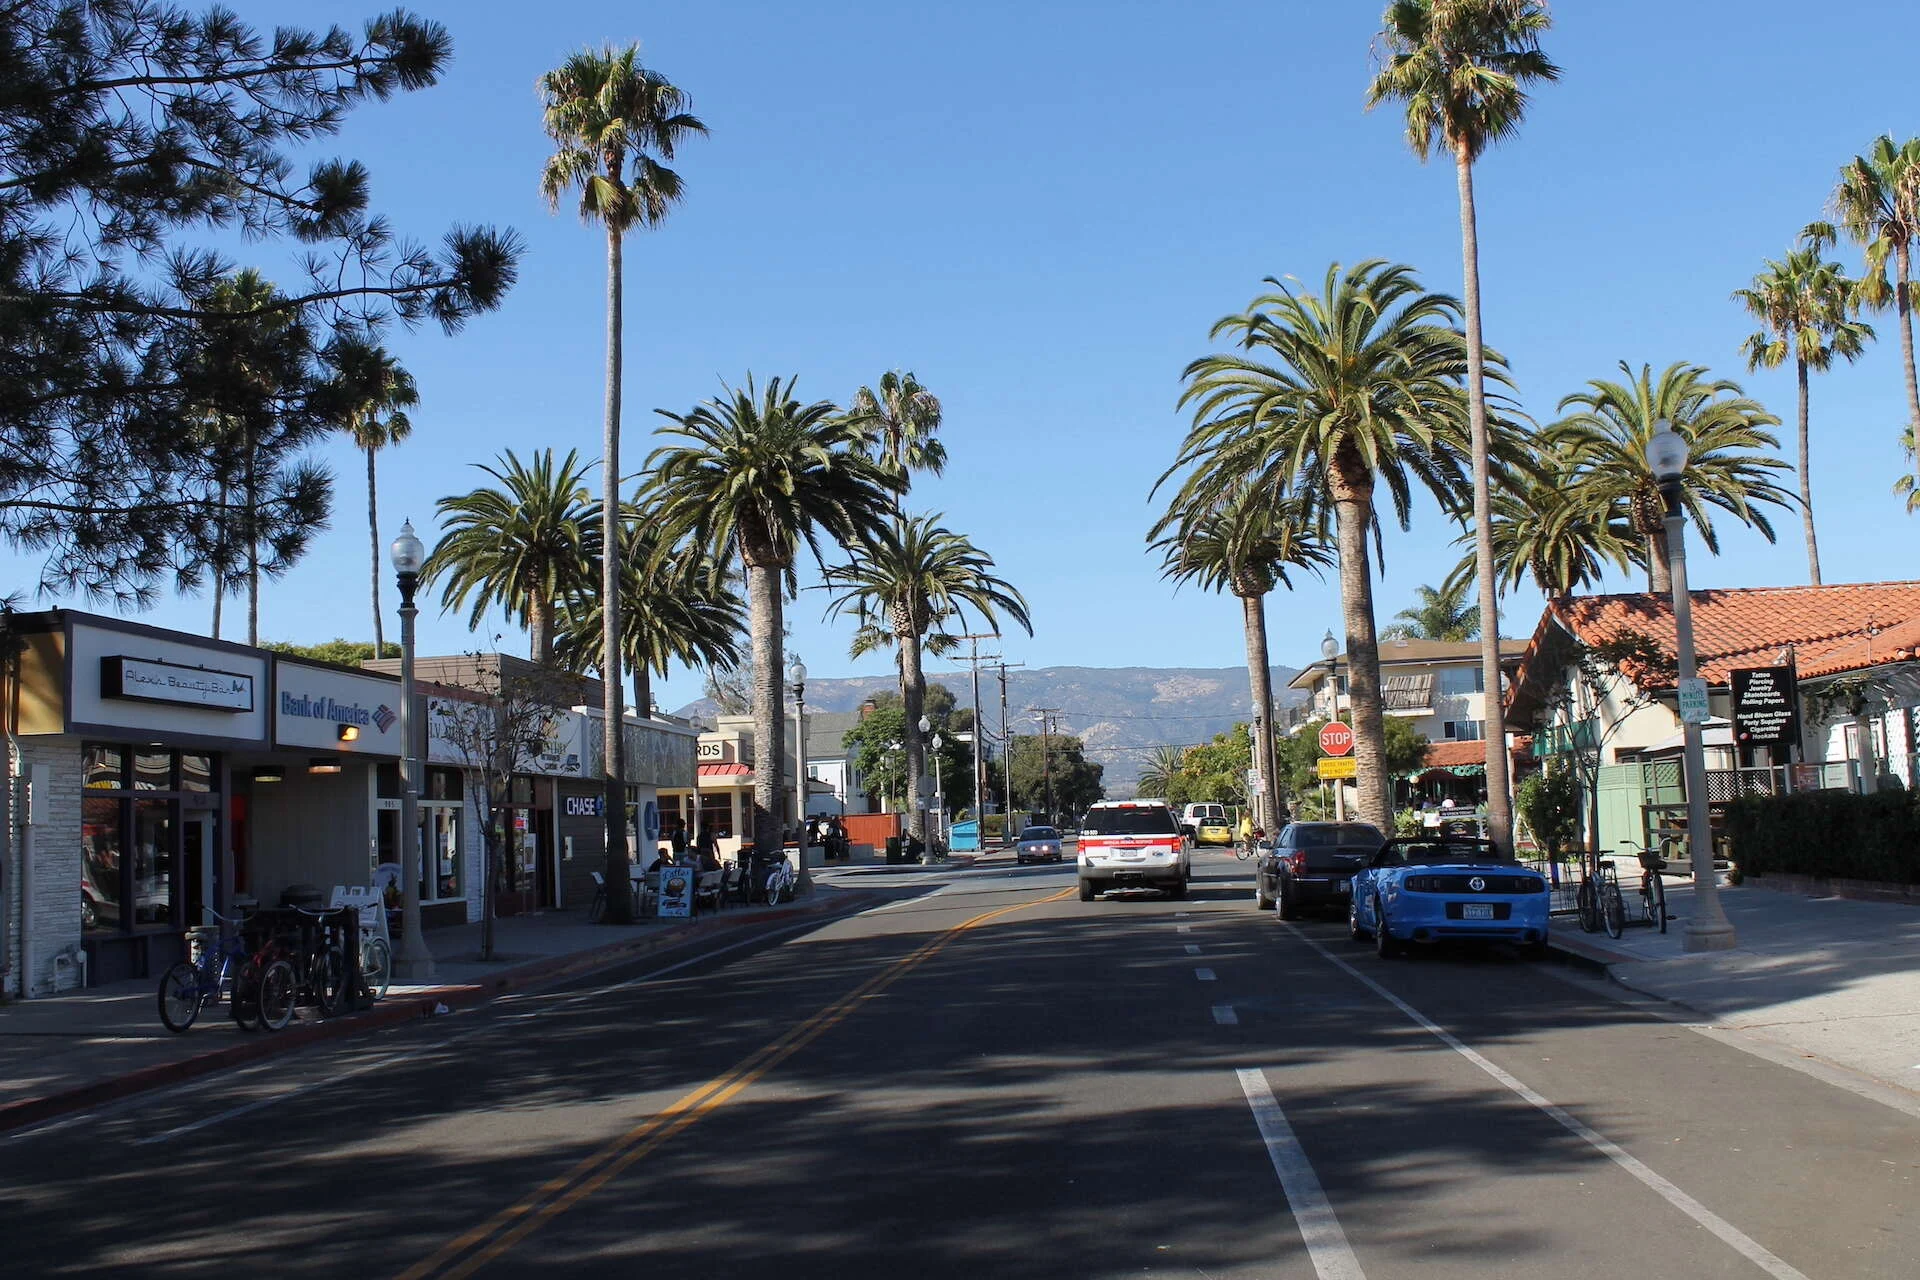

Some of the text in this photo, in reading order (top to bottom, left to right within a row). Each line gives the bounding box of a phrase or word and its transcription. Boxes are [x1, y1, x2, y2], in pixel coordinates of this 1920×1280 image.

[168, 676, 209, 699] Beauty
[281, 690, 369, 725] Bank of America
[1741, 697, 1784, 706] Rolling Papers
[1737, 712, 1753, 720] Hand
[1754, 711, 1773, 719] Blown
[1760, 718, 1786, 726] Supplies
[1321, 732, 1351, 746] STOP
[566, 797, 596, 816] CHASE
